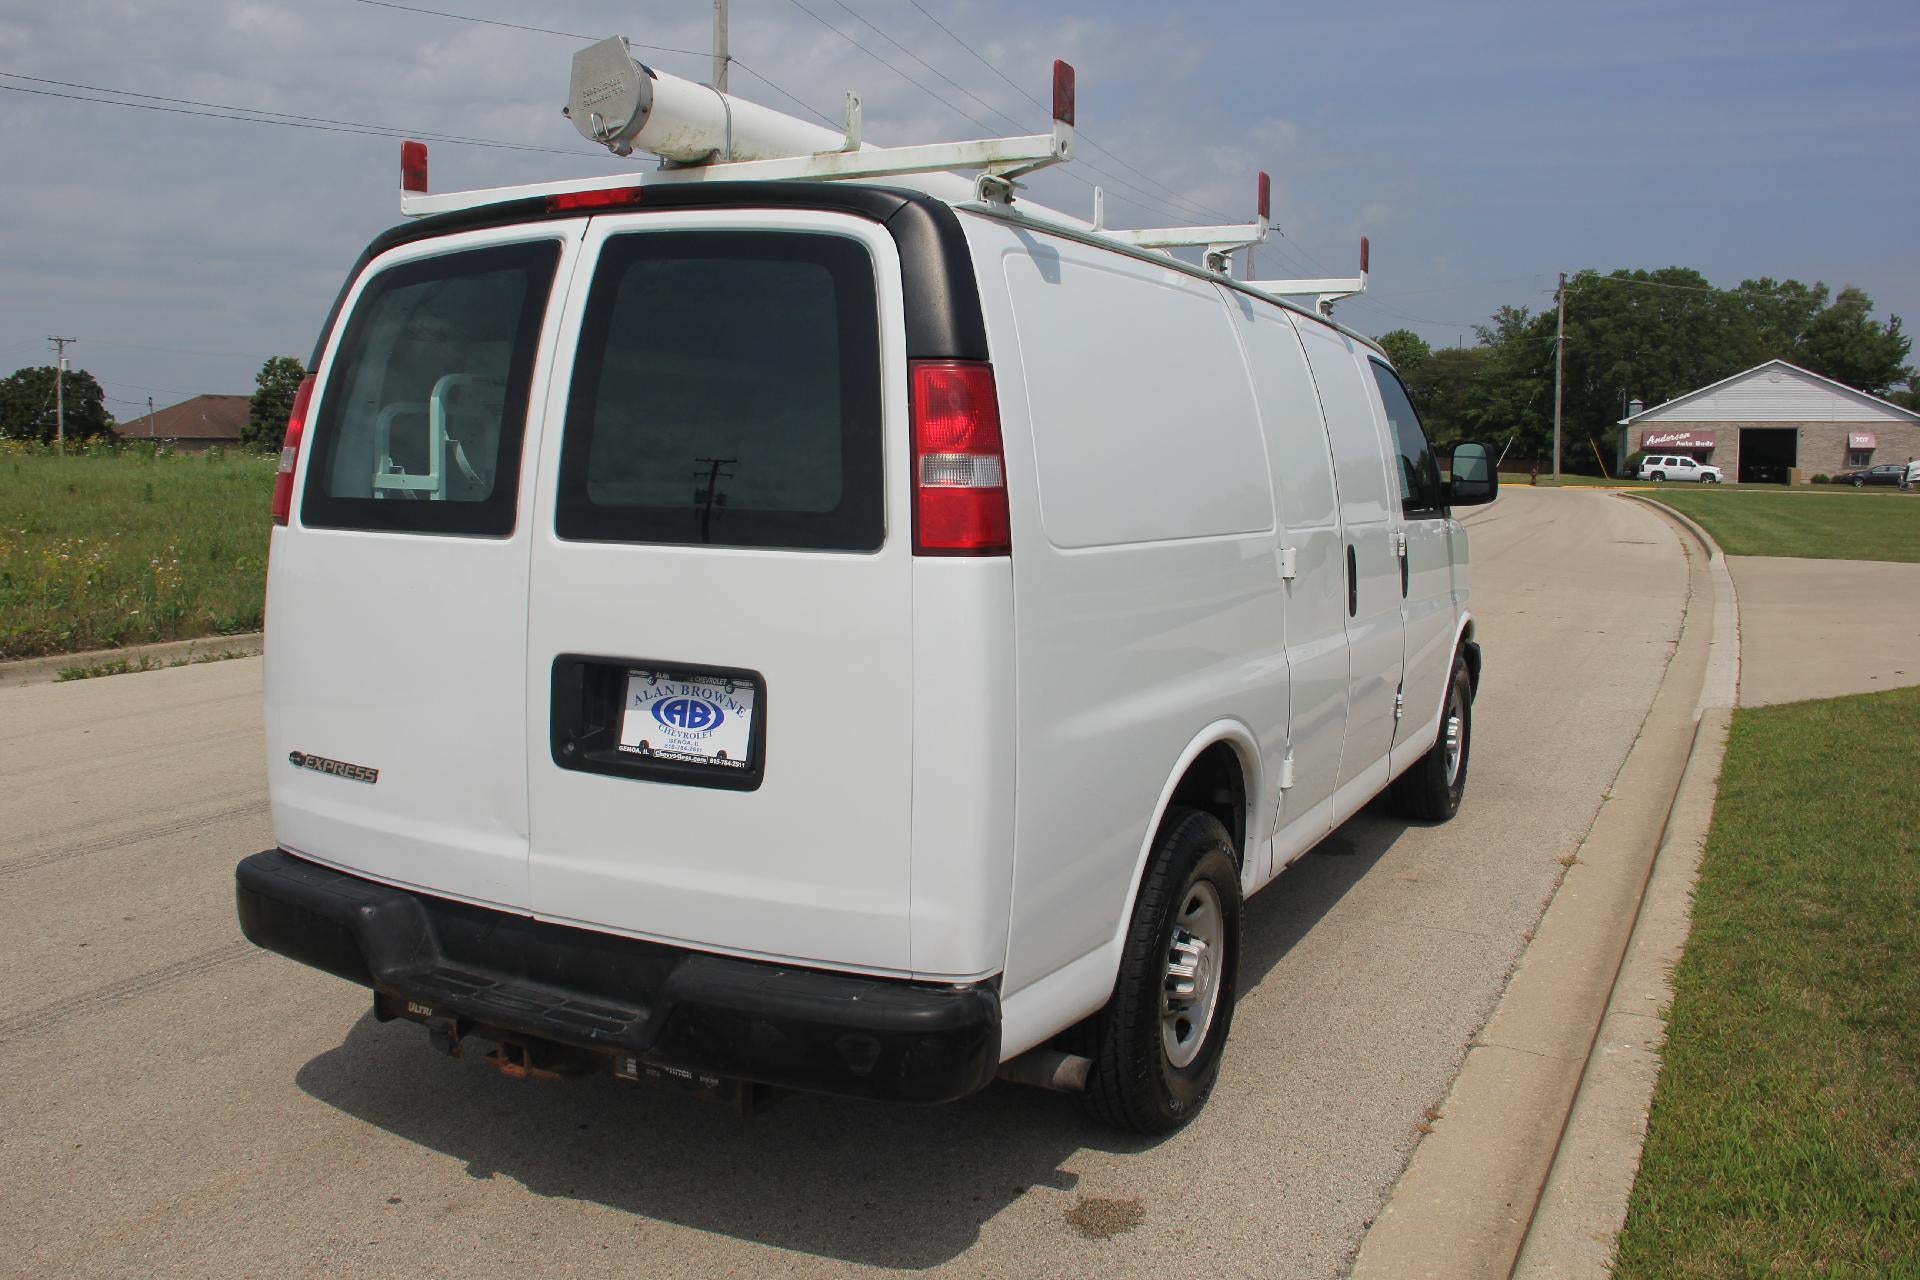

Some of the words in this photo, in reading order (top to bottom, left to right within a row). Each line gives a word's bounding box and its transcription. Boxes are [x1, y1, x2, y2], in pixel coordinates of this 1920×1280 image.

[694, 675, 728, 686] CHEVROLET
[633, 684, 676, 706] ALAN
[681, 684, 747, 718] BROWNE
[658, 723, 713, 740] CHEVROLET
[305, 754, 379, 784] EXPRESS
